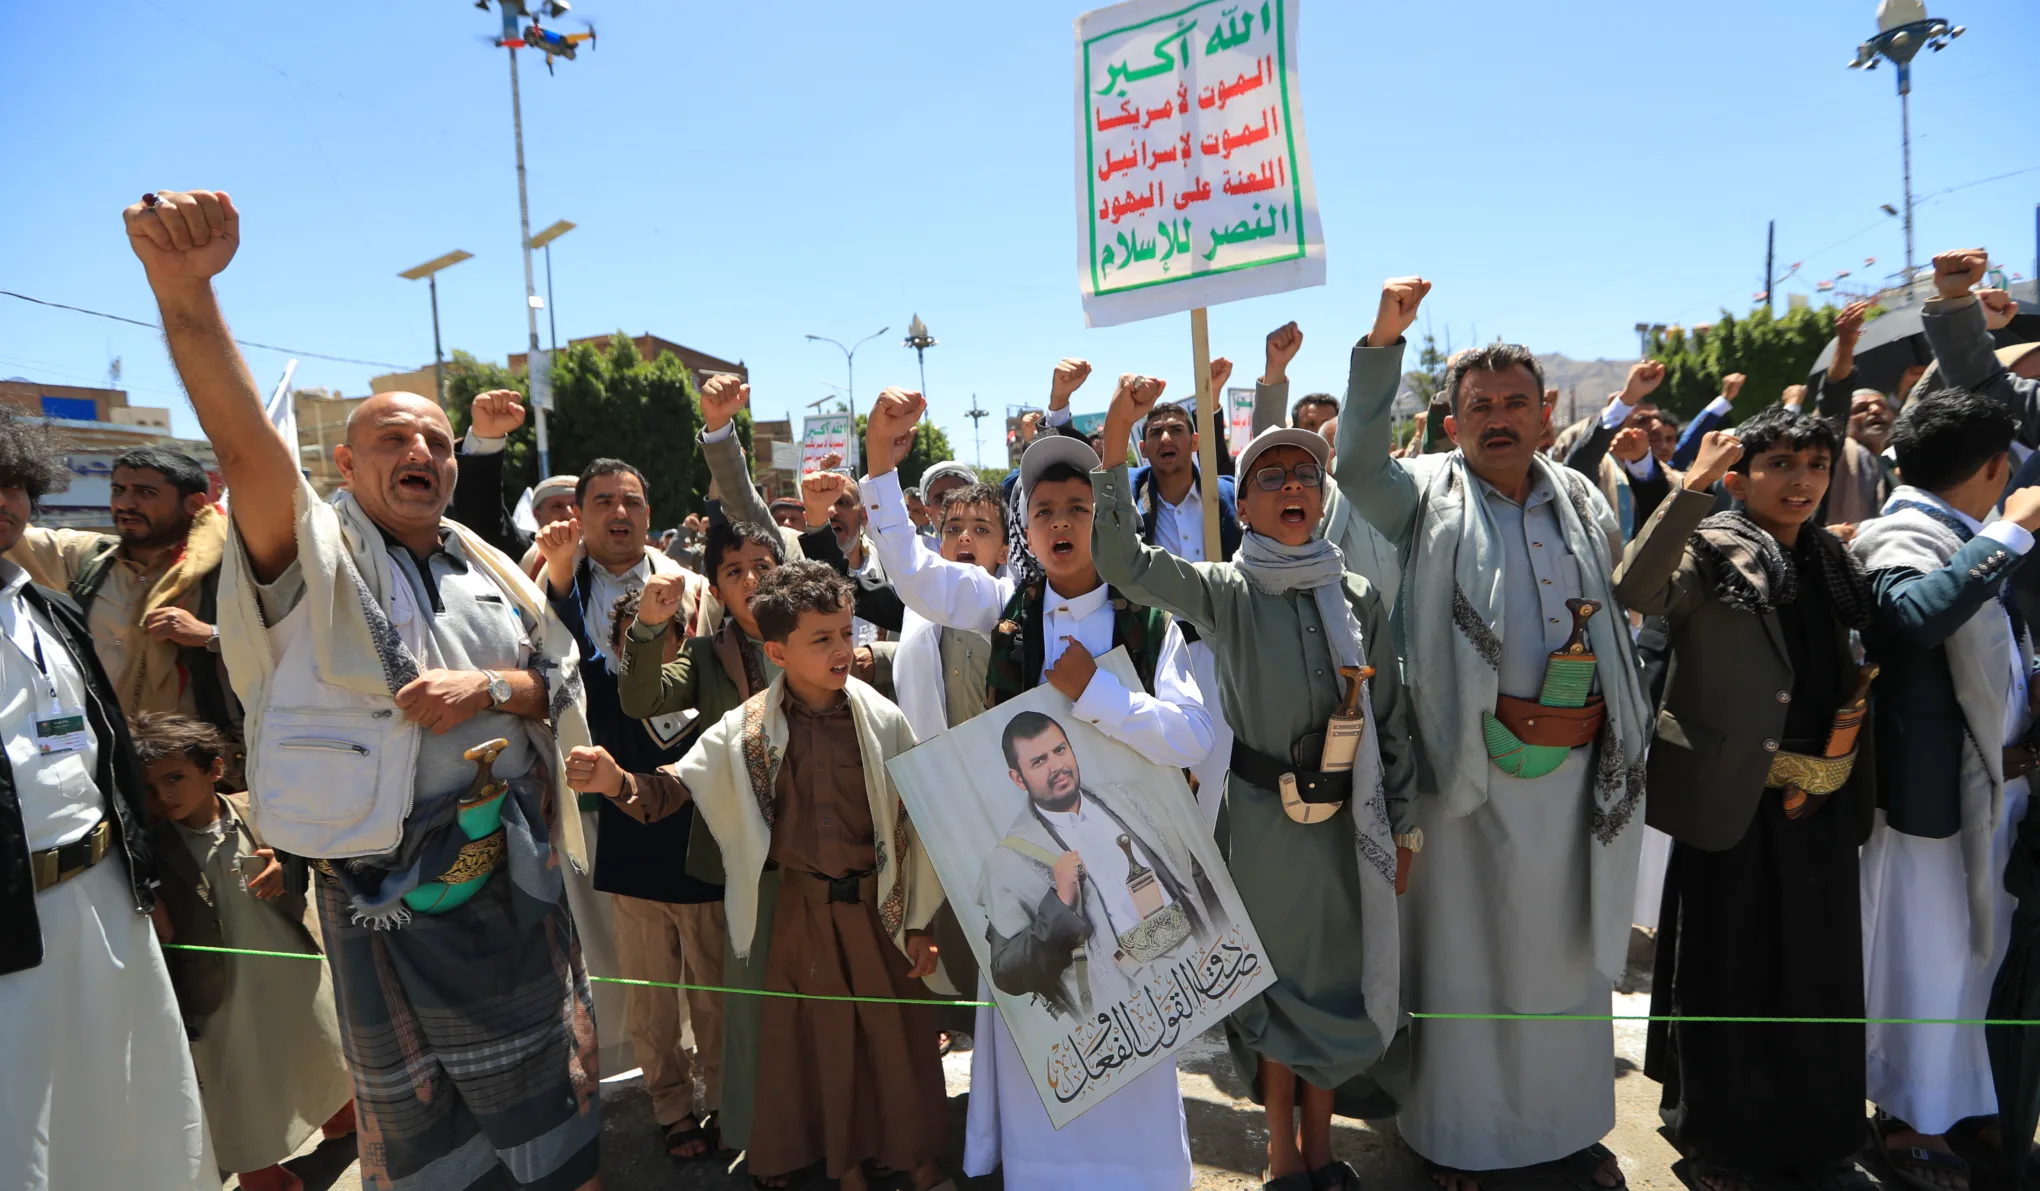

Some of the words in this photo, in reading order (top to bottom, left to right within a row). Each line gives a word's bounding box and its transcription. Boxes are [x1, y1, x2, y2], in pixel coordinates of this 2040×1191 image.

[1206, 1, 1271, 56] الله
[1095, 19, 1198, 97] أكبر
[1198, 54, 1272, 110] الموت
[1096, 81, 1189, 132] لأمريكا
[1201, 104, 1278, 160] الموت
[1098, 131, 1192, 181] لإسرائيل
[1222, 155, 1286, 196] اللعنة
[1099, 180, 1164, 224] اليهود
[1173, 175, 1212, 211] على
[1101, 216, 1192, 280] للإسلام
[1201, 202, 1289, 261] النصر
[1134, 962, 1201, 1057] القول
